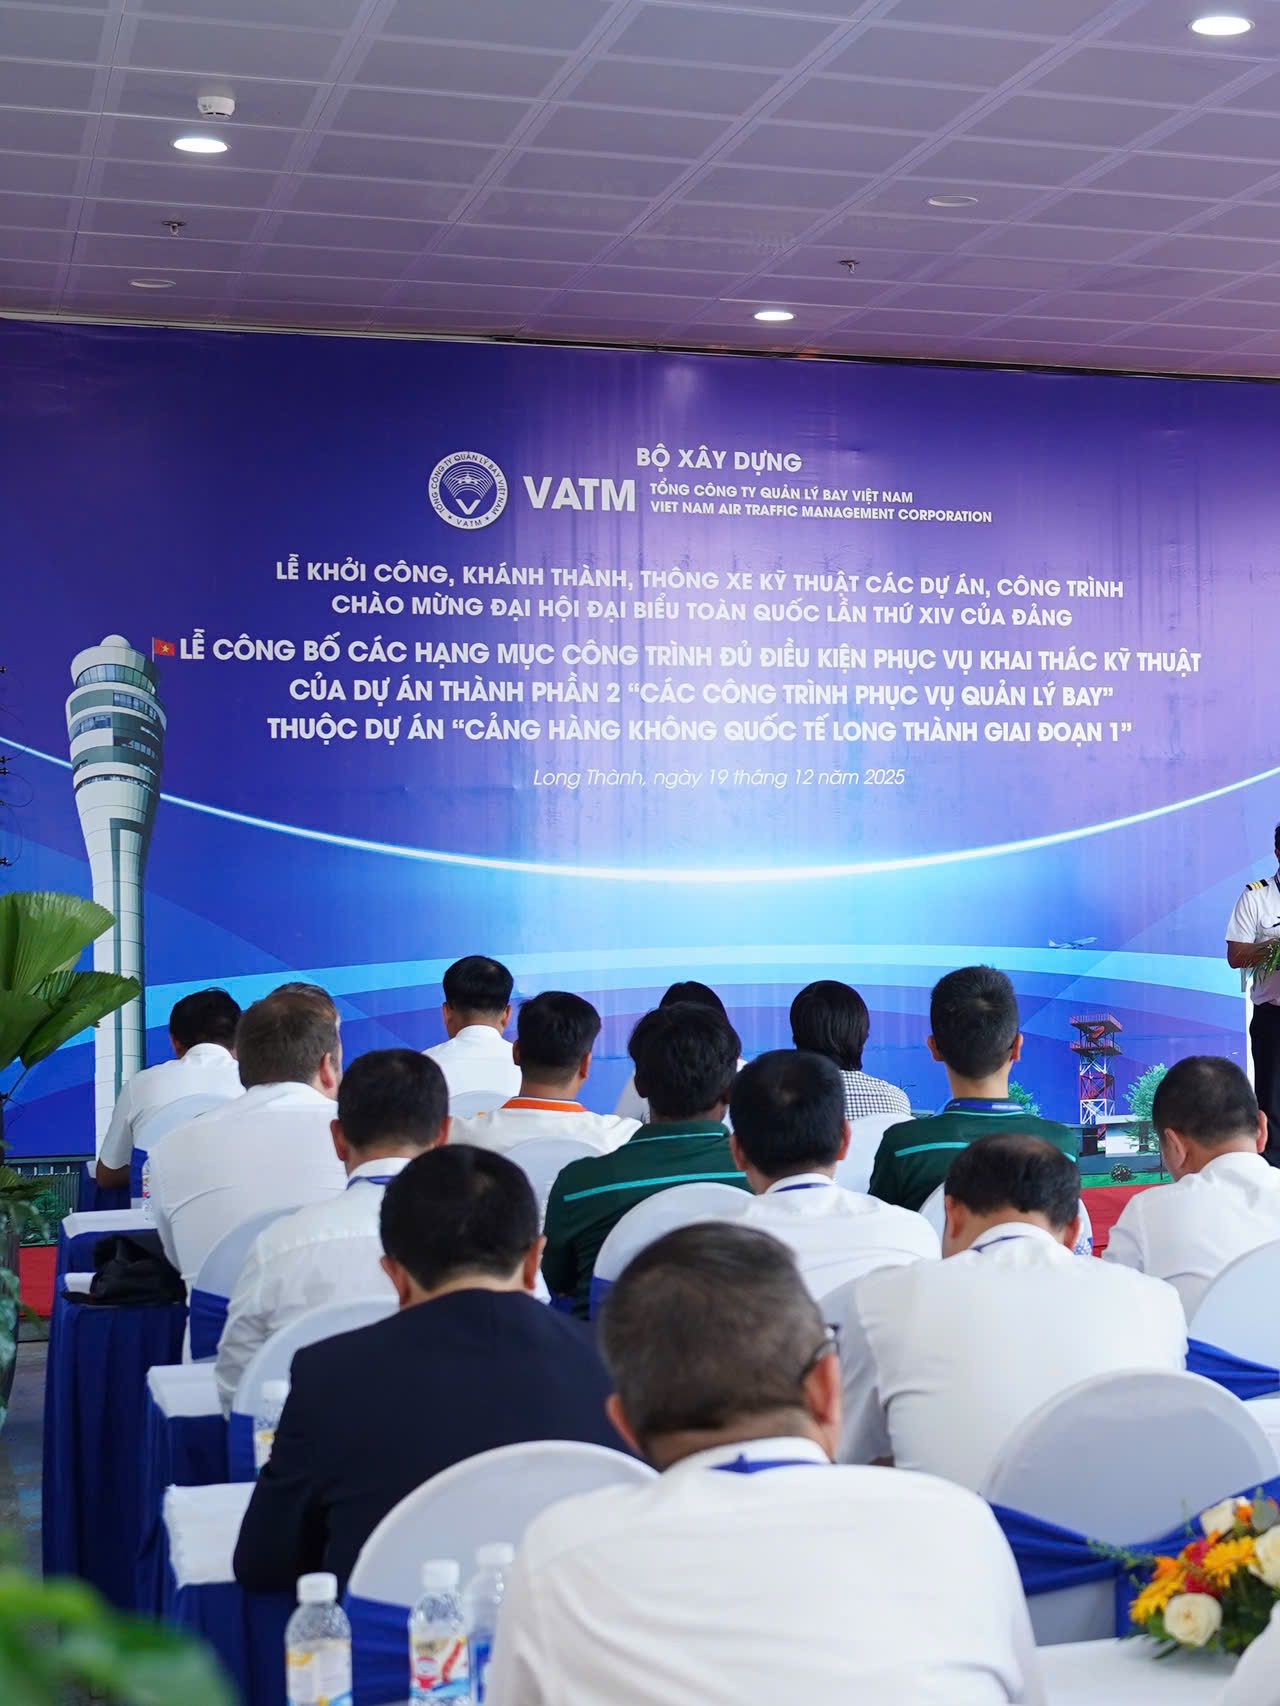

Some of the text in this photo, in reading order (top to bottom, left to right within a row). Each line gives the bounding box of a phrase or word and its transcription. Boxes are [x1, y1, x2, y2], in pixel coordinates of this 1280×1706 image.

[444, 457, 453, 466] TY
[488, 463, 501, 477] BAY
[637, 443, 802, 474] BỘ XÂY DỰNG
[431, 465, 445, 489] CÔNG
[523, 476, 635, 511] VATM
[650, 478, 912, 504] TỔNG CÔNG TY QUẢN LÝ BAY VIỆT NAM
[491, 497, 504, 515] NAM
[651, 501, 991, 522] VIET NAM AIR TRAFFIC MANAGEMENT CORPORATION
[456, 519, 482, 527] VATM
[277, 554, 1123, 599] LỄ KHỞI CÔNG, KHÁNH THÀNH, THÔNG XE KỸ THUẬT CÁC DỰ ÁN, CÔNG TRÌNH
[332, 591, 1072, 626] CHÀO MỪNG ĐẠI HỘI ĐẠI BIỂU TOÀN QUỐC LẦN THỨ XIV CỦA ĐẢNG
[181, 629, 1201, 677] LỄ CÔNG BỐ CÁC HẠNG MỤC CÔNG TRÌNH ĐỦ ĐIỀU KIỆN PHỤC VỤ KHAI THÁC KỸ THUẬT
[290, 672, 1113, 711] CỦA DỰ ÁN THÀNH PHẦN 2 “CÁC CÔNG TRÌNH PHỤC VỤ QUẢN LÝ BAY”
[267, 712, 1131, 747] THUỘC DỰ ÁN “CẢNG HÀNG KHÔNG QUỐC TẾ LONG THÀNH GIAI ĐOẠN 1”
[534, 767, 905, 789] Long Thành, ngày 19 tháng 12 năm 2025
